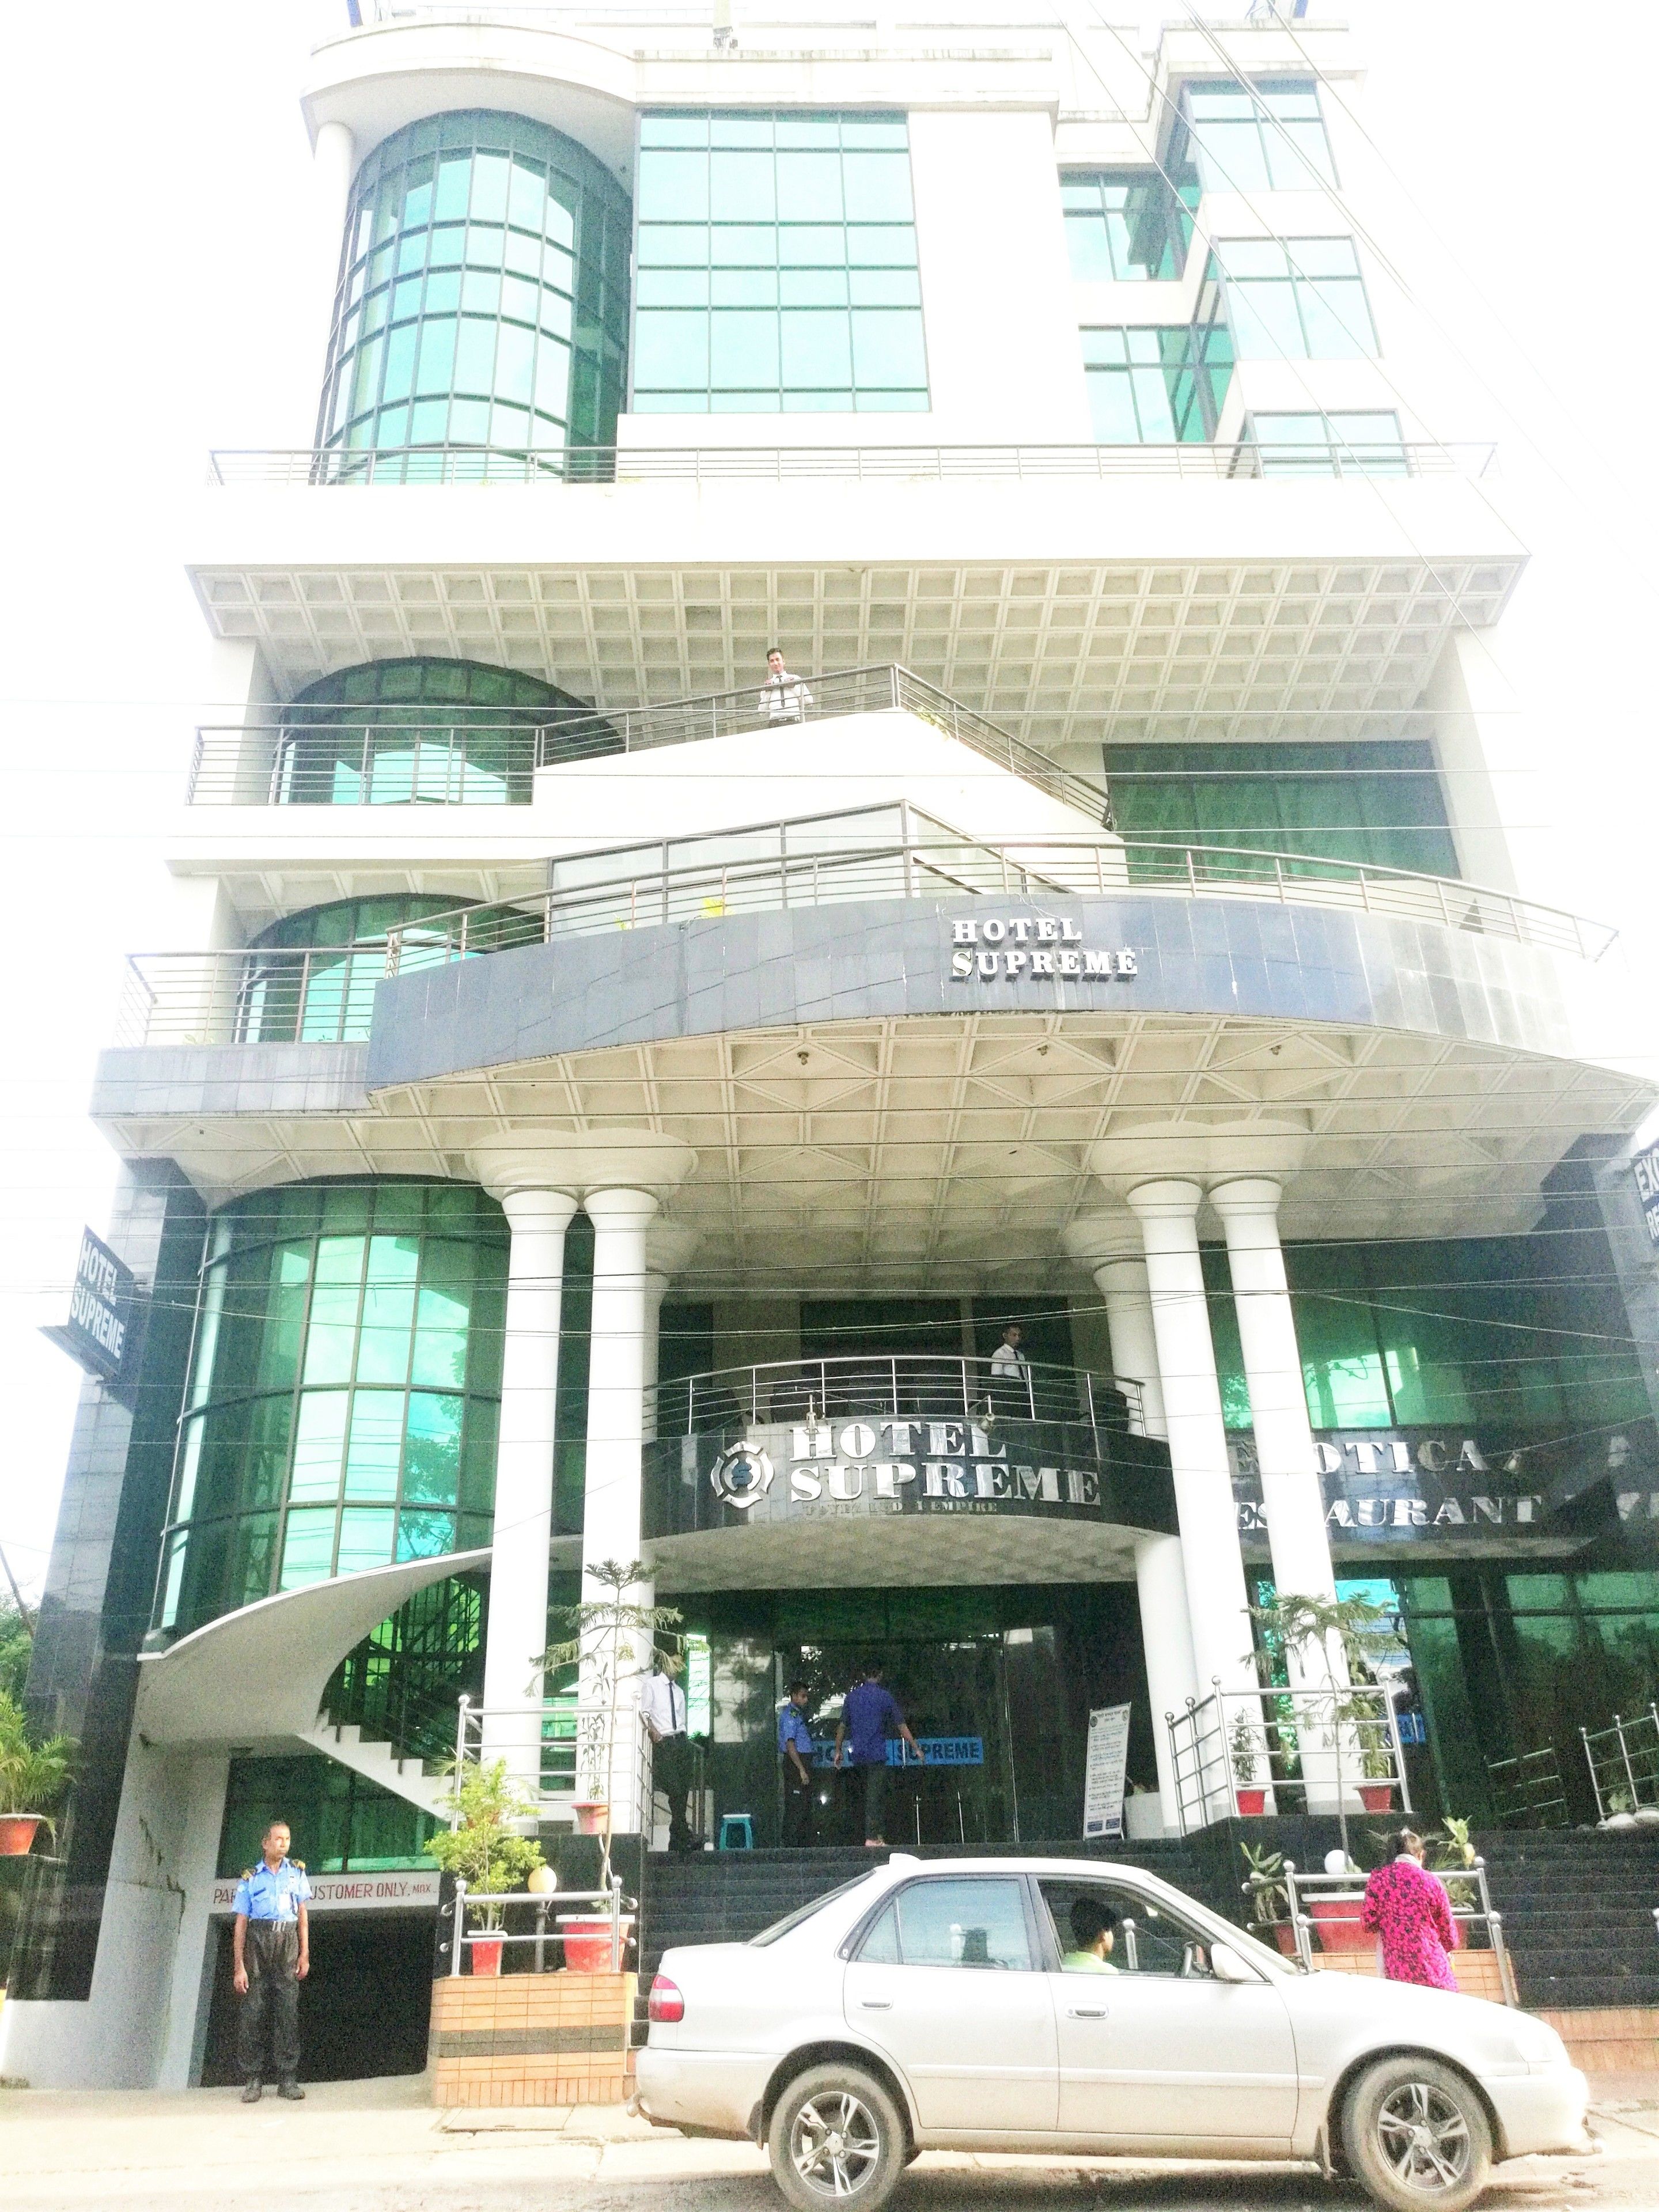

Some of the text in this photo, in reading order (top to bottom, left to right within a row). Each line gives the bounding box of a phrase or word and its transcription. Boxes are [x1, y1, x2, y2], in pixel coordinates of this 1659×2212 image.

[952, 918, 1082, 942] HOTEL
[952, 950, 1138, 976] SUPREME
[78, 1240, 118, 1307] HOTEL
[71, 1282, 125, 1359] SUPREME
[789, 1422, 1007, 1462] HOTEL
[1228, 1440, 1491, 1476] EOTICA
[791, 1463, 1101, 1505] SUPREME
[897, 1743, 979, 1760] SUPREME
[310, 1883, 373, 1900] USTOMER
